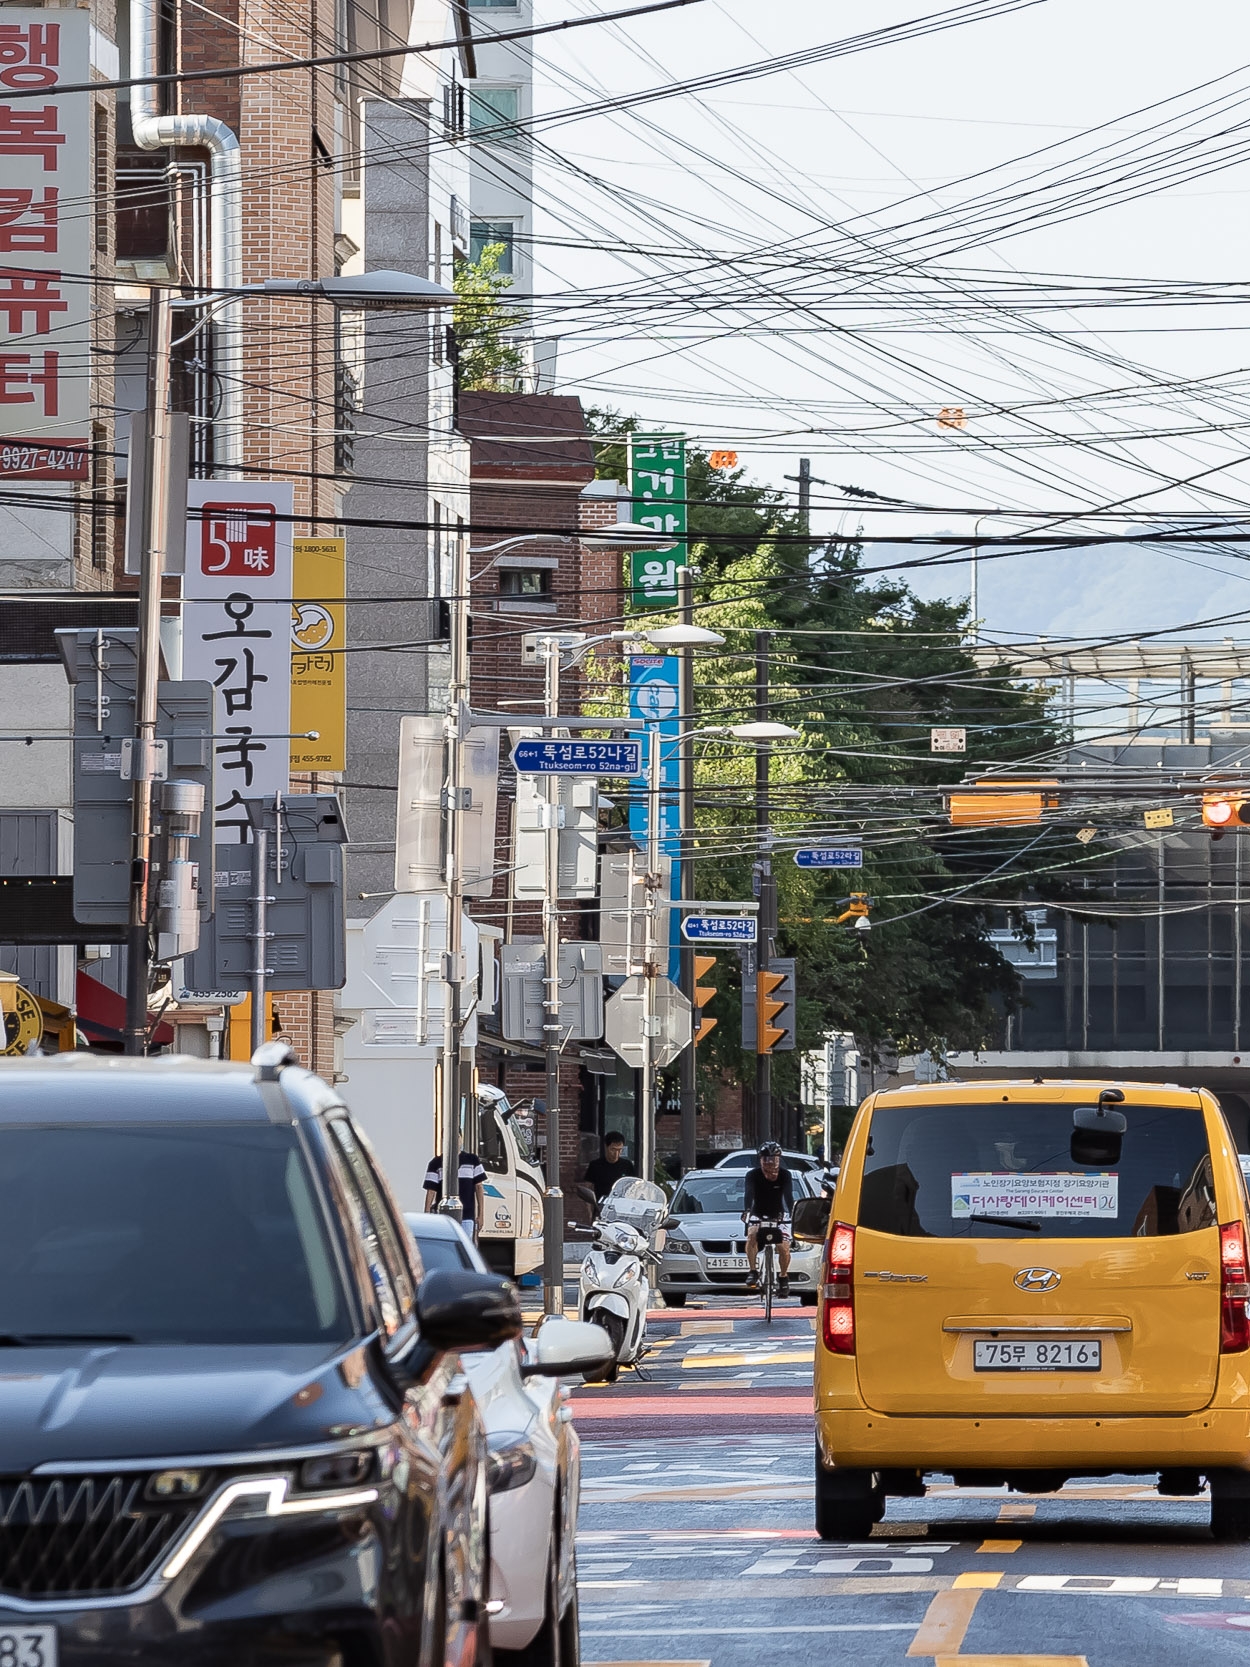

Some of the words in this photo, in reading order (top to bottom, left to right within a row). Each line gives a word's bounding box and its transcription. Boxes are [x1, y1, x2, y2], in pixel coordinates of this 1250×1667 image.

[244, 546, 270, 571] 味
[542, 744, 636, 761] 뚝섬로52나길
[539, 761, 596, 770] Ttukseom-ro
[599, 762, 636, 772] 52na-gil
[983, 1180, 1061, 1188] 노인장기요양보험지정
[1063, 1180, 1110, 1188] 장기요양기관
[972, 1195, 1097, 1209] 더사랑데이케어센터
[986, 1345, 1026, 1363] 75무
[1036, 1344, 1088, 1363] 8216
